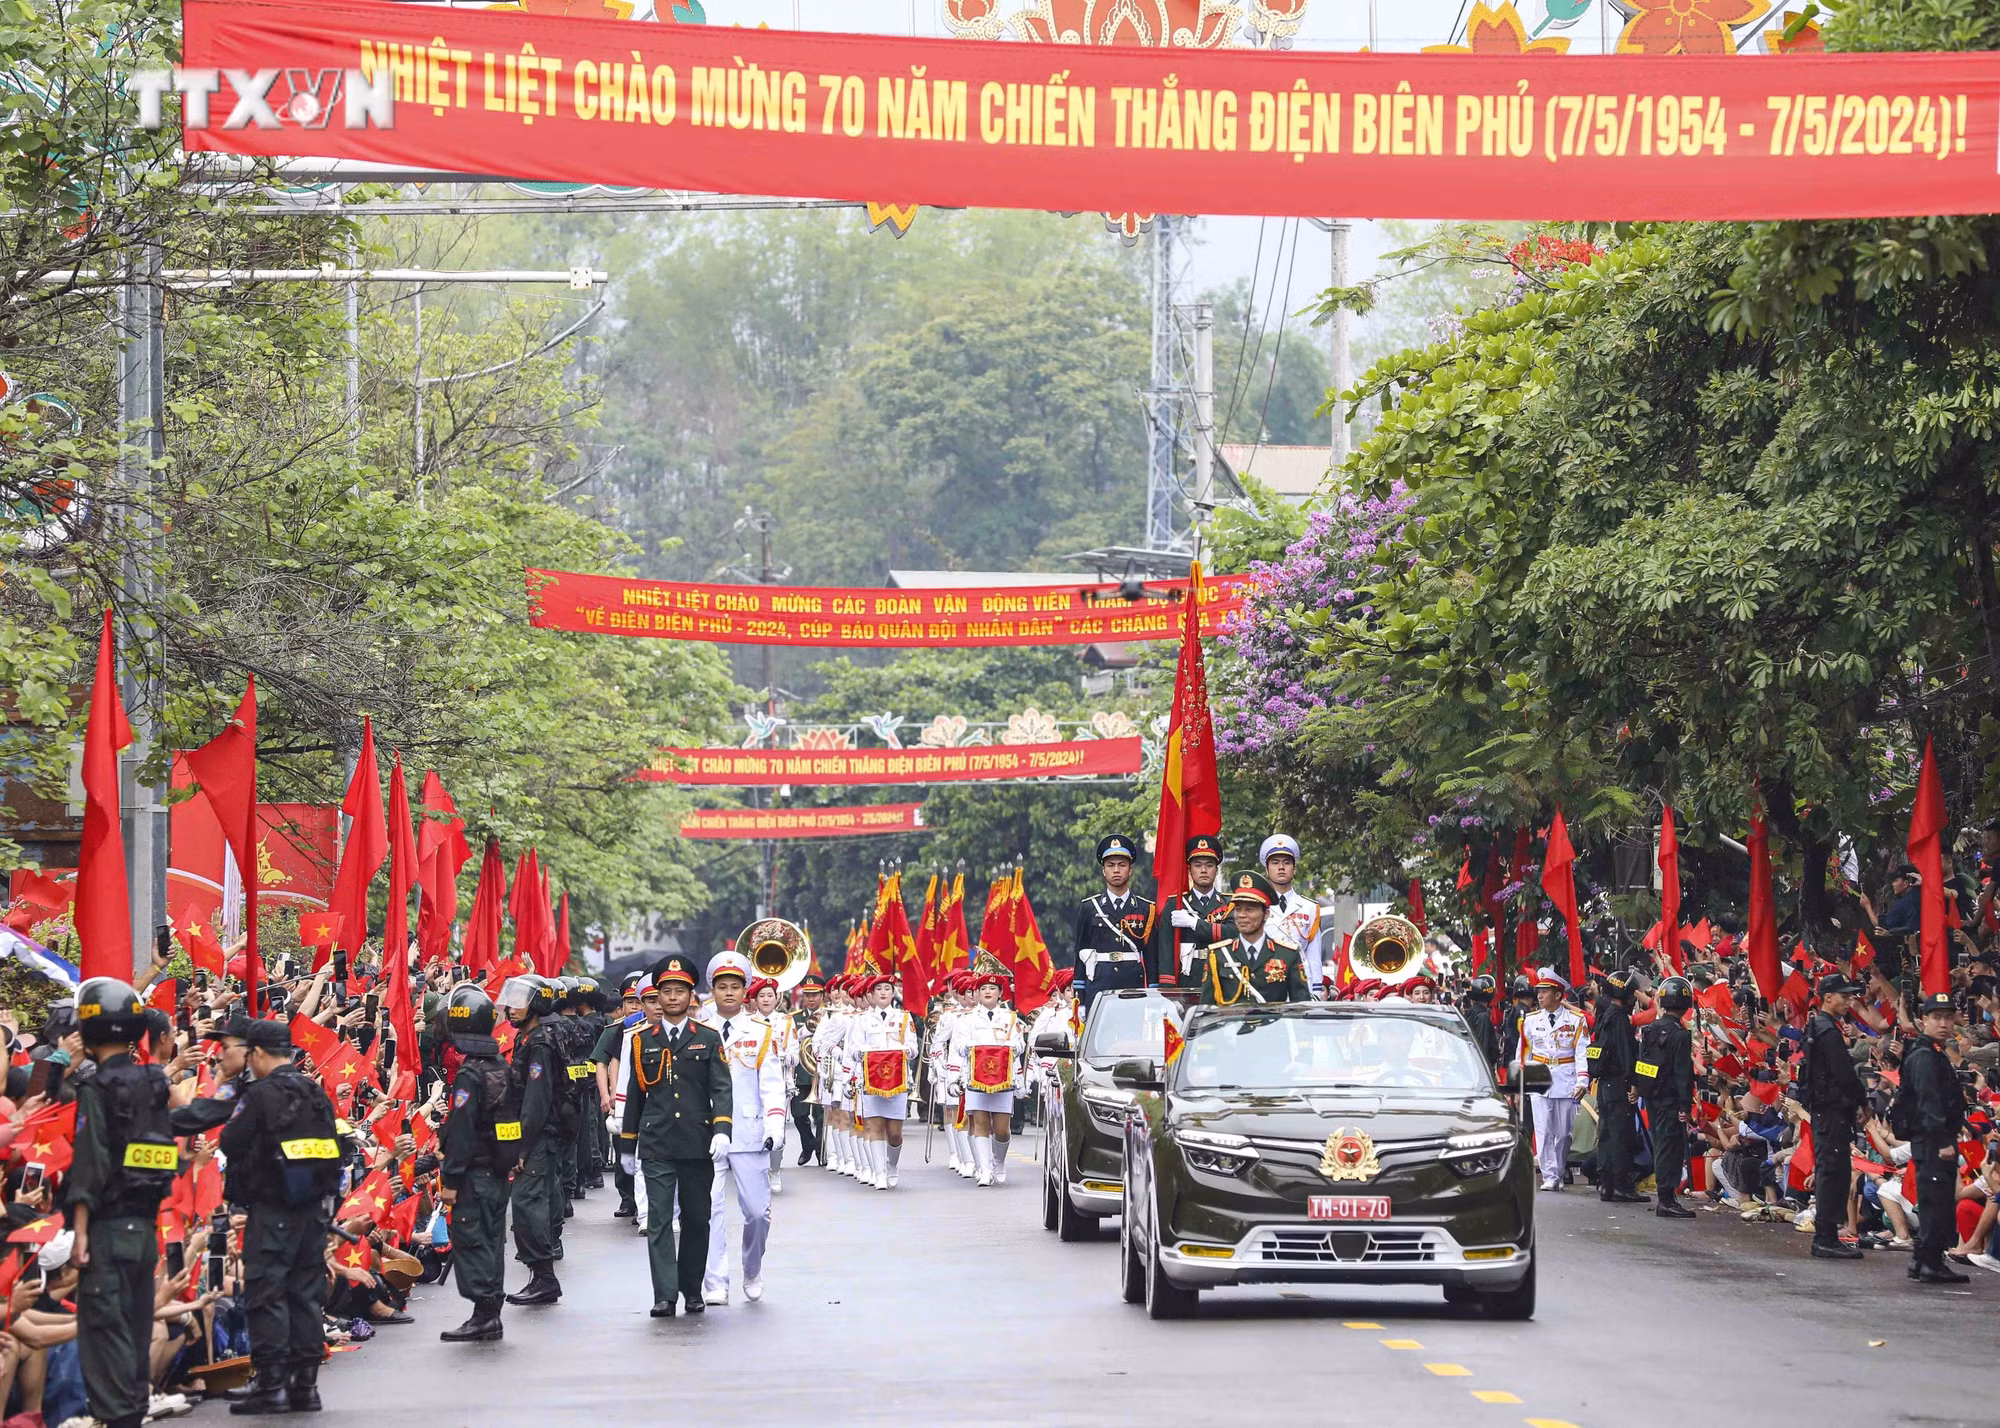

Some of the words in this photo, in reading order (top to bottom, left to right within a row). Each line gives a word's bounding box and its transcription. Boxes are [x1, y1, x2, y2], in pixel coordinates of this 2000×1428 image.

[484, 42, 562, 124] LIỆT
[573, 52, 677, 127] CHÀO
[691, 56, 809, 133] MỪNG
[818, 75, 867, 137] 70
[878, 67, 969, 142] NĂM
[979, 69, 1097, 148] CHIẾN
[1110, 73, 1239, 152] THẮNG
[1248, 79, 1340, 163] ĐIỆN
[1351, 80, 1445, 156] BIÊN
[1455, 79, 1534, 158] PHỦ
[1544, 94, 1727, 163] (7/5/1954
[1739, 122, 1755, 137] -
[1767, 94, 1968, 161] 7/5/2024)!
[623, 587, 672, 609] NHIỆT
[676, 589, 711, 612] LIỆT
[715, 592, 760, 612] CHÀO
[771, 593, 823, 613] MỪNG
[832, 595, 866, 614] CÁC
[874, 594, 922, 615] ĐOÀN
[933, 593, 968, 616] VẬN
[982, 592, 1029, 616] ĐỘNG
[1032, 591, 1071, 611] VIÊN
[609, 610, 650, 631] ĐIỆN
[698, 614, 733, 633] PHỦ
[746, 621, 792, 639] 2024,
[799, 619, 833, 638] CÚP
[841, 620, 874, 639] BÁO
[878, 620, 924, 640] QUÂN
[928, 619, 957, 640] ĐỘI
[966, 618, 1014, 638] NHÂN
[1069, 615, 1104, 634] CÁC
[1110, 614, 1168, 635] CHẶNG
[701, 755, 732, 774] CHÀO
[733, 754, 768, 775] MỪNG
[769, 759, 784, 774] 70
[786, 755, 812, 775] NĂM
[813, 755, 847, 775] CHIẾN
[887, 755, 914, 776] ĐIỆN
[915, 753, 942, 773] BIÊN
[943, 751, 967, 772] PHỦ
[969, 753, 1019, 771] (7/5/1954
[1029, 750, 1085, 768] 7/5/2024)!
[131, 1148, 173, 1165] CSCĐ
[1311, 1199, 1388, 1218] TM-01-70
